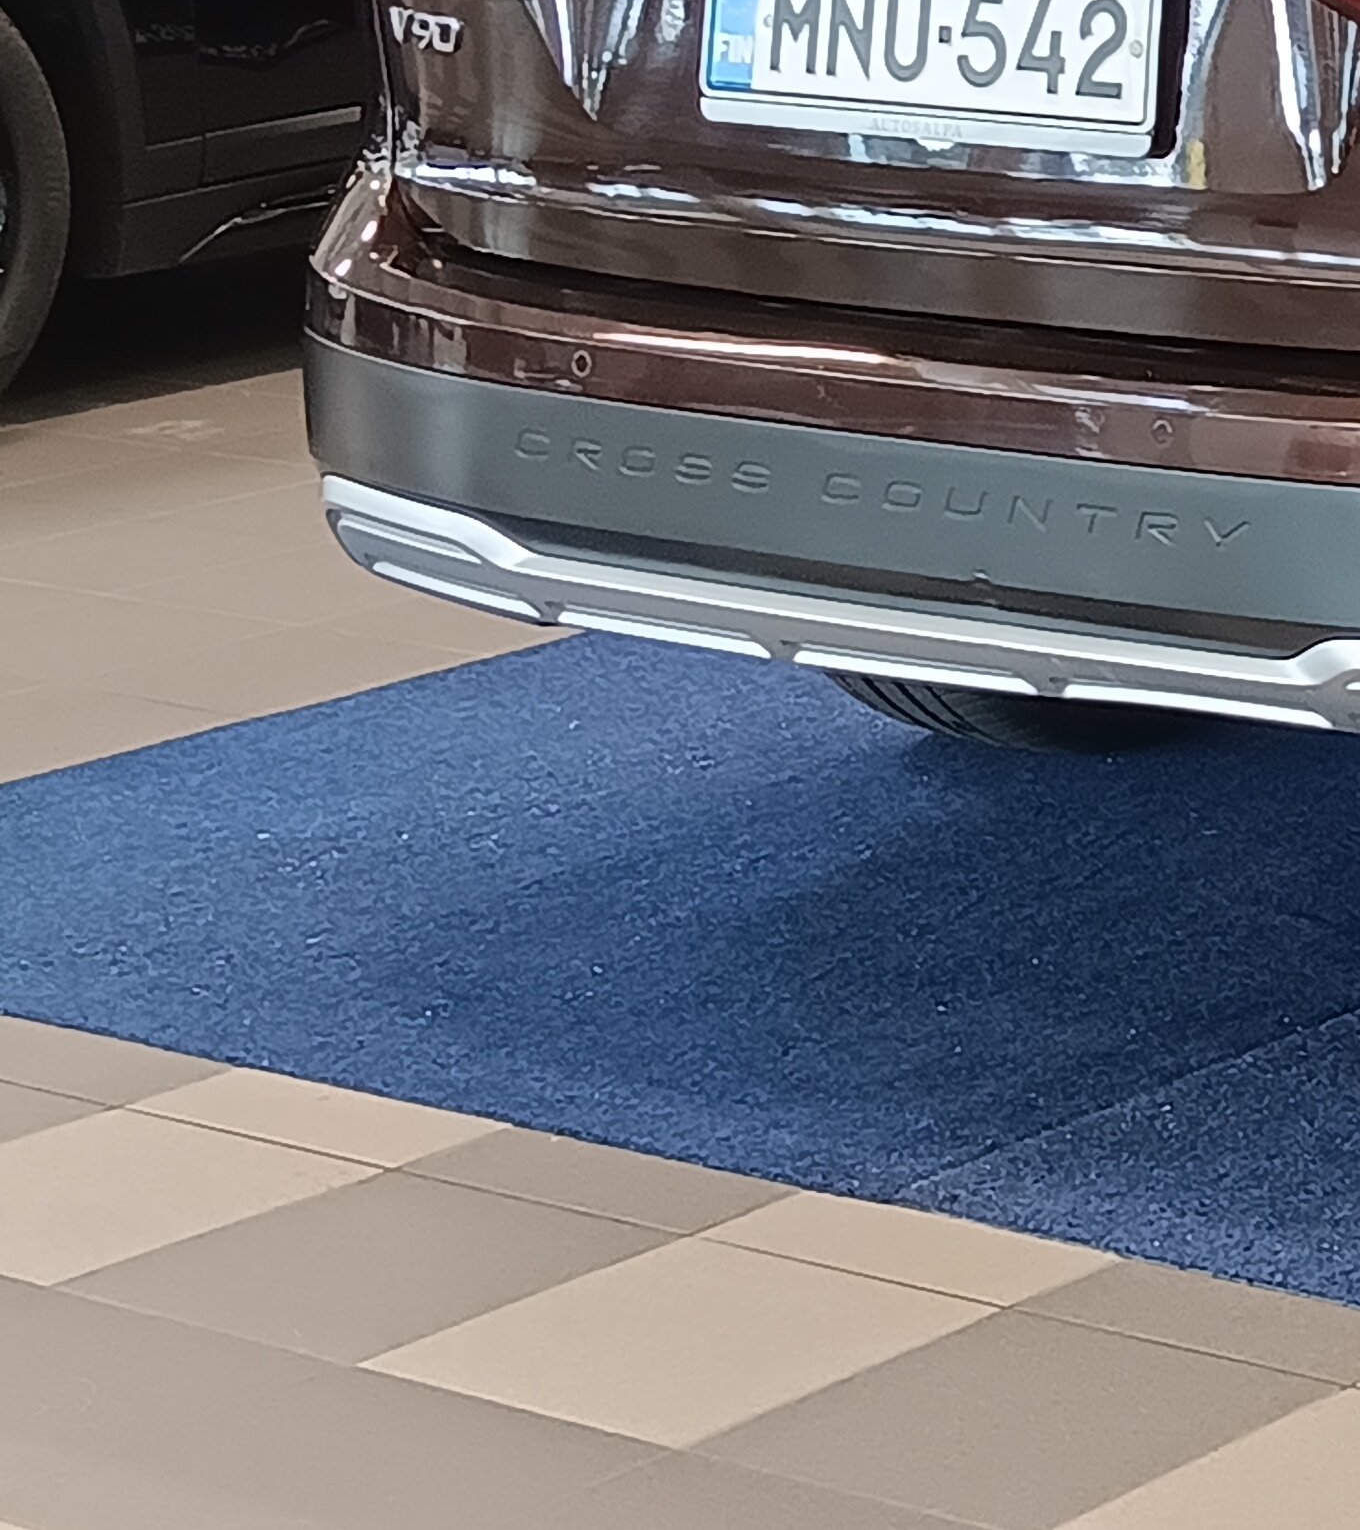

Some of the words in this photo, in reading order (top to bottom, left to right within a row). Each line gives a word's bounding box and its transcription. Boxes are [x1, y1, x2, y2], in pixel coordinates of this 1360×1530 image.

[388, 5, 461, 53] V90
[714, 32, 754, 66] FIN
[865, 116, 964, 139] AUTOSALPA
[514, 424, 773, 494] CROSS
[820, 472, 1252, 549] COUNTRY
